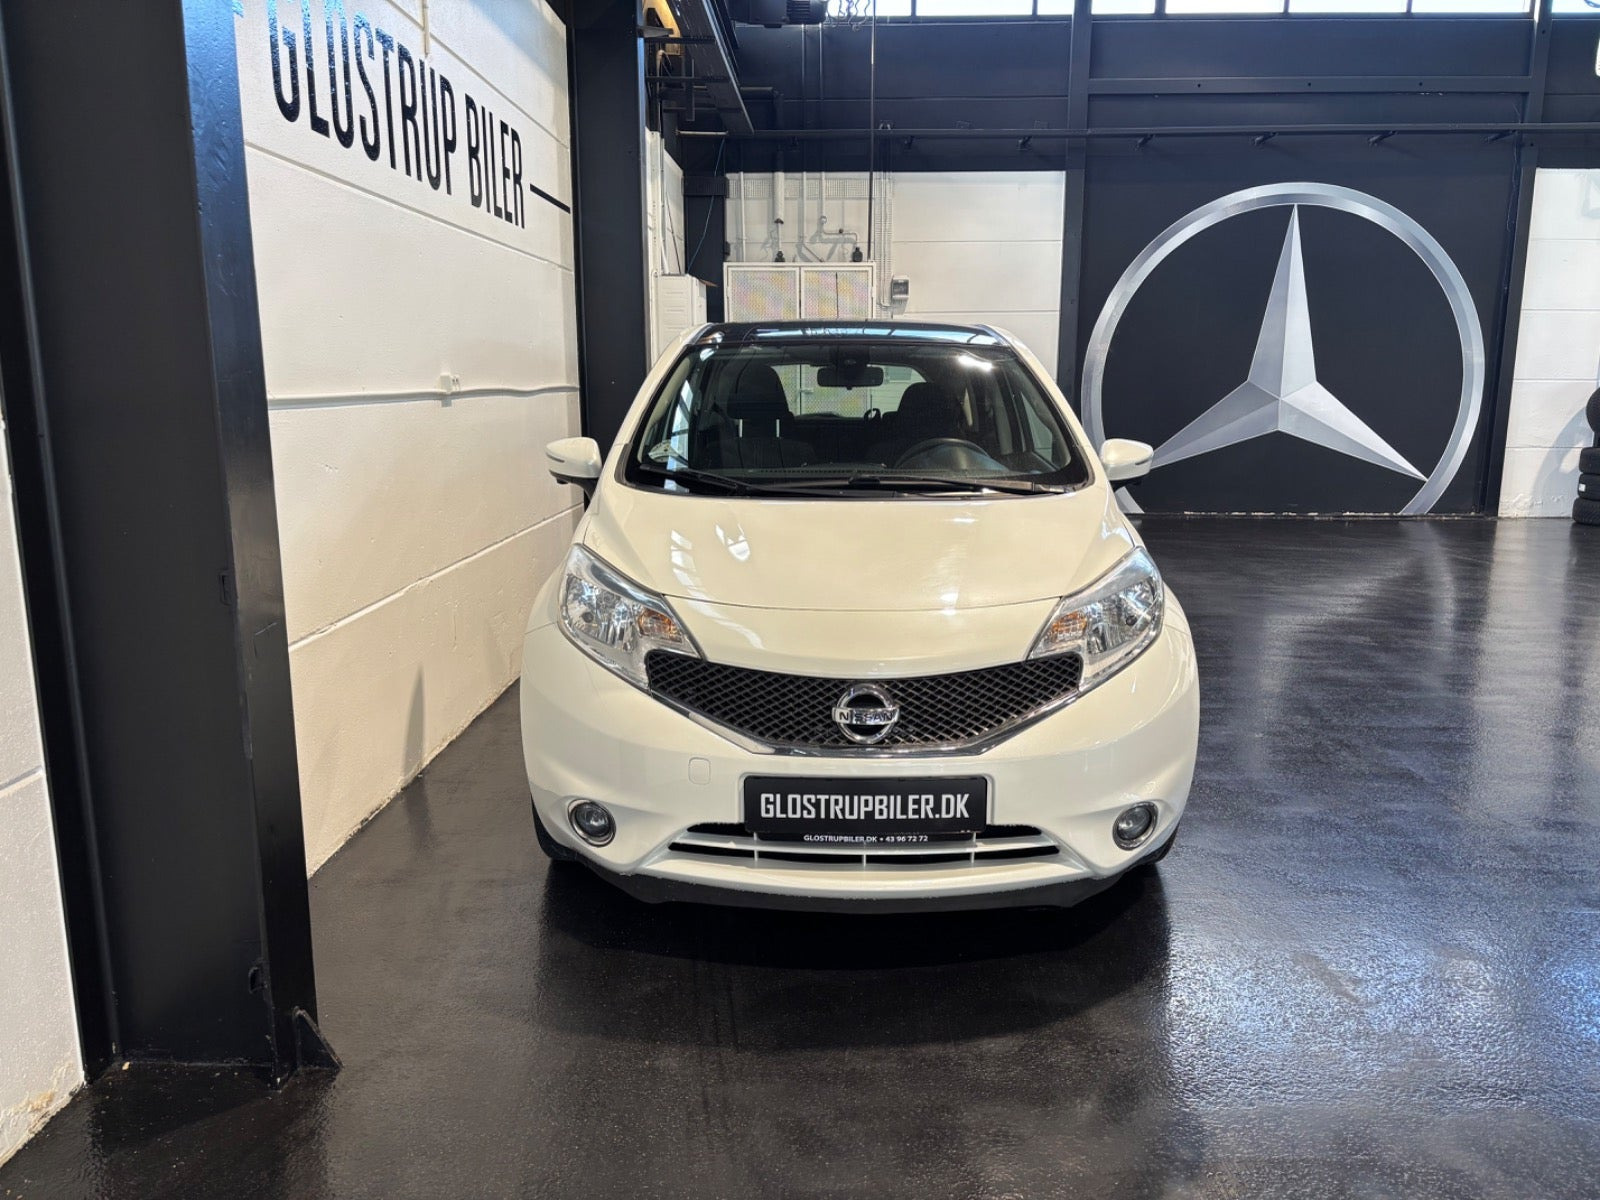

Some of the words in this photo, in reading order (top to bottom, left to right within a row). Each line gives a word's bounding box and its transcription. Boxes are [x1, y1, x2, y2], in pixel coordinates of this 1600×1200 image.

[267, 0, 457, 195] GLOSTRUP
[464, 93, 525, 229] BILER
[760, 793, 970, 820] GLOSTRUPBILER.DK
[803, 834, 877, 843] GLOSTRUPBILER.DK
